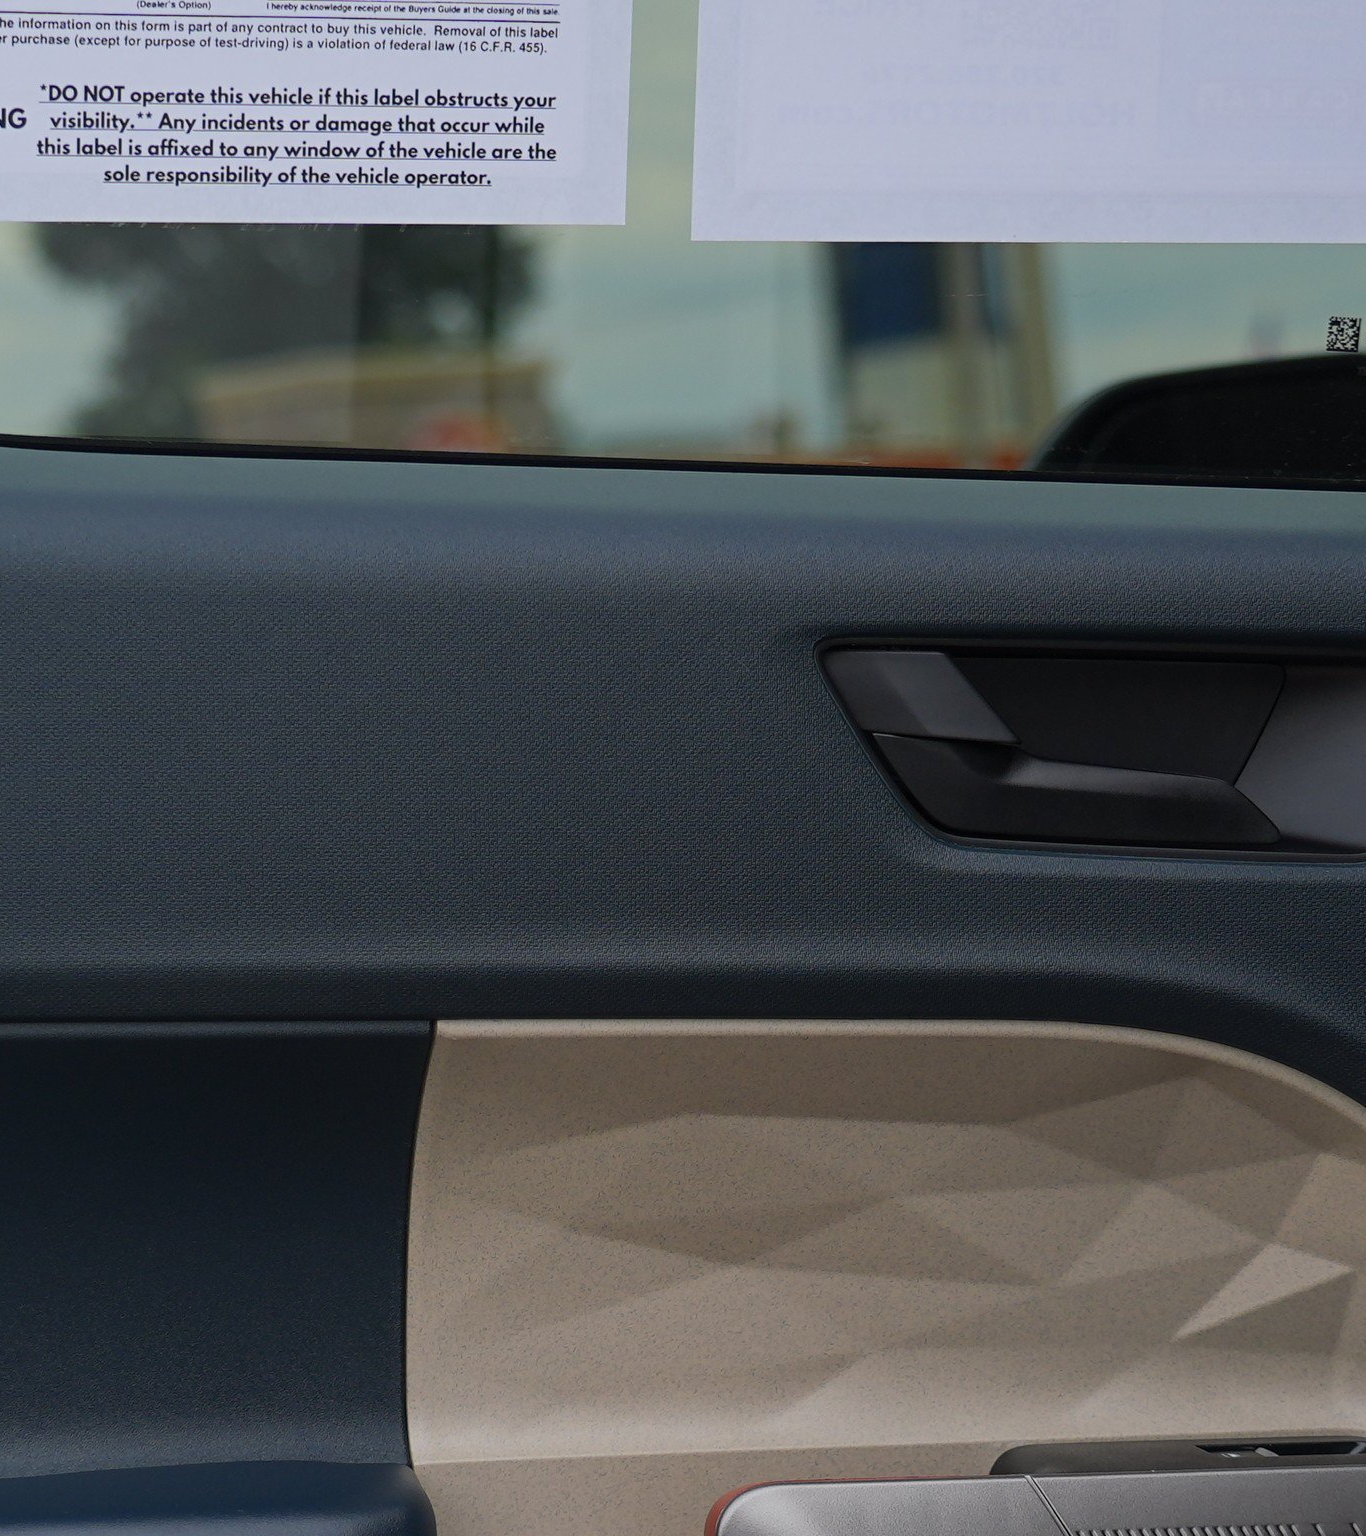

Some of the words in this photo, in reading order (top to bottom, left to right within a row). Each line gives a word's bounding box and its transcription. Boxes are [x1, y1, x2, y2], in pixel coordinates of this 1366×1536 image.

[17, 17, 92, 31] information
[95, 22, 112, 32] on
[114, 19, 138, 32] this
[141, 19, 171, 33] form
[173, 20, 185, 33] is
[187, 20, 213, 37] part
[215, 21, 229, 33] of
[231, 24, 255, 37] any
[256, 21, 309, 35] contract
[310, 22, 324, 35] to
[326, 22, 351, 39] buy
[353, 23, 377, 36] this
[379, 23, 428, 37] vehicle.
[433, 24, 487, 38] Removal
[489, 25, 503, 38] of
[504, 26, 527, 38] this
[529, 26, 560, 39] label
[10, 32, 71, 50] purchase
[73, 33, 121, 51] (except
[123, 34, 143, 48] for
[144, 38, 196, 52] purpose
[198, 36, 212, 49] of
[214, 36, 290, 54] test-driving)
[292, 37, 304, 50] is
[316, 38, 371, 51] violation
[373, 39, 388, 52] of
[388, 39, 433, 52] federal
[434, 40, 456, 53] law
[457, 40, 478, 56] (16
[479, 40, 517, 53] C.F.R.
[518, 41, 548, 57] 455).
[83, 84, 126, 102] NOT
[129, 84, 206, 108] operate
[209, 85, 244, 103] this
[247, 86, 314, 104] vehicle
[318, 86, 333, 104] if
[334, 86, 369, 105] this
[373, 87, 420, 105] label
[423, 87, 509, 106] obstructs
[512, 93, 557, 111] your
[157, 112, 195, 135] Any
[201, 113, 285, 131] incidents
[288, 118, 311, 131] or
[314, 114, 393, 136] damage
[397, 114, 436, 132] that
[439, 119, 490, 132] occur
[493, 115, 546, 132] while
[35, 138, 72, 156] this
[75, 138, 124, 156] label
[127, 138, 143, 156] is
[146, 139, 216, 157] affixed
[219, 139, 239, 157] to
[242, 144, 278, 162] any
[283, 140, 362, 158] window
[365, 141, 388, 158] of
[388, 141, 419, 158] the
[422, 141, 487, 159] vehicle
[490, 147, 524, 159] are
[527, 142, 558, 159] the
[103, 164, 142, 182] sole
[145, 164, 274, 188] responsibility
[276, 165, 298, 183] of
[300, 166, 332, 183] the
[334, 166, 400, 184] vehicle
[403, 167, 492, 189] operator.
